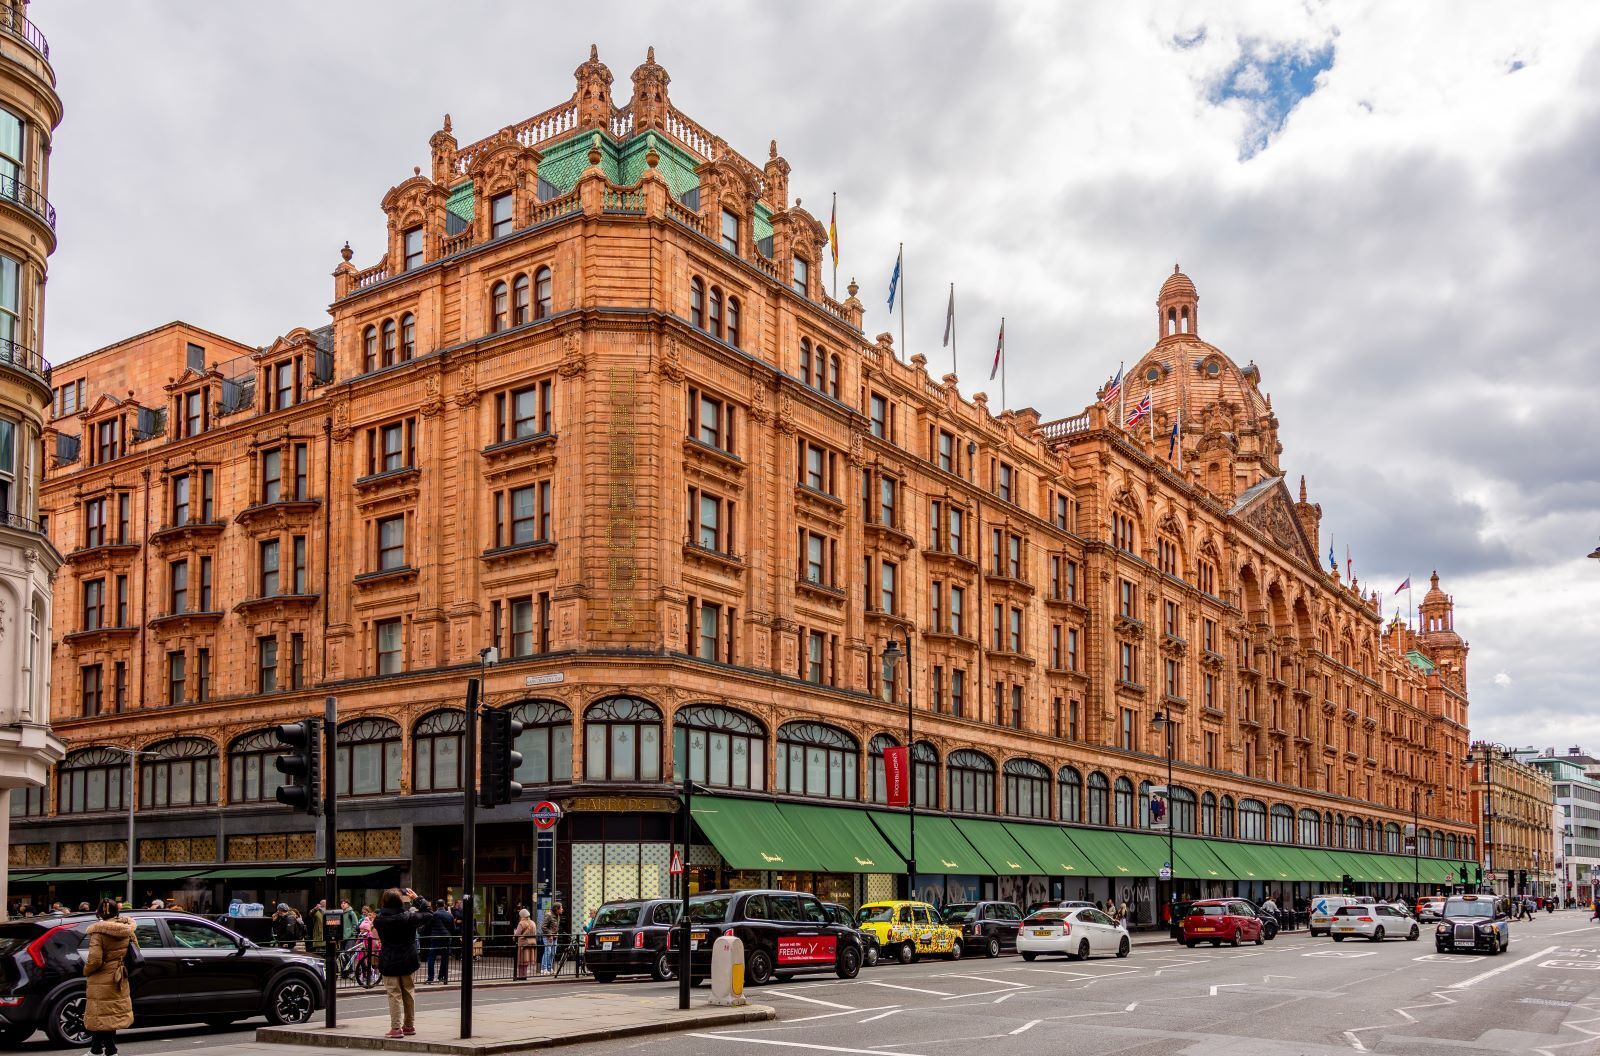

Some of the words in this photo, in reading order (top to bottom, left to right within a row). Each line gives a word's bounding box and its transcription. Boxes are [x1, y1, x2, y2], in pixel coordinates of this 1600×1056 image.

[606, 366, 638, 629] HARRODS
[577, 798, 647, 810] HARRODS
[1115, 886, 1155, 902] MOYNAT
[779, 947, 808, 956] FREENOW
